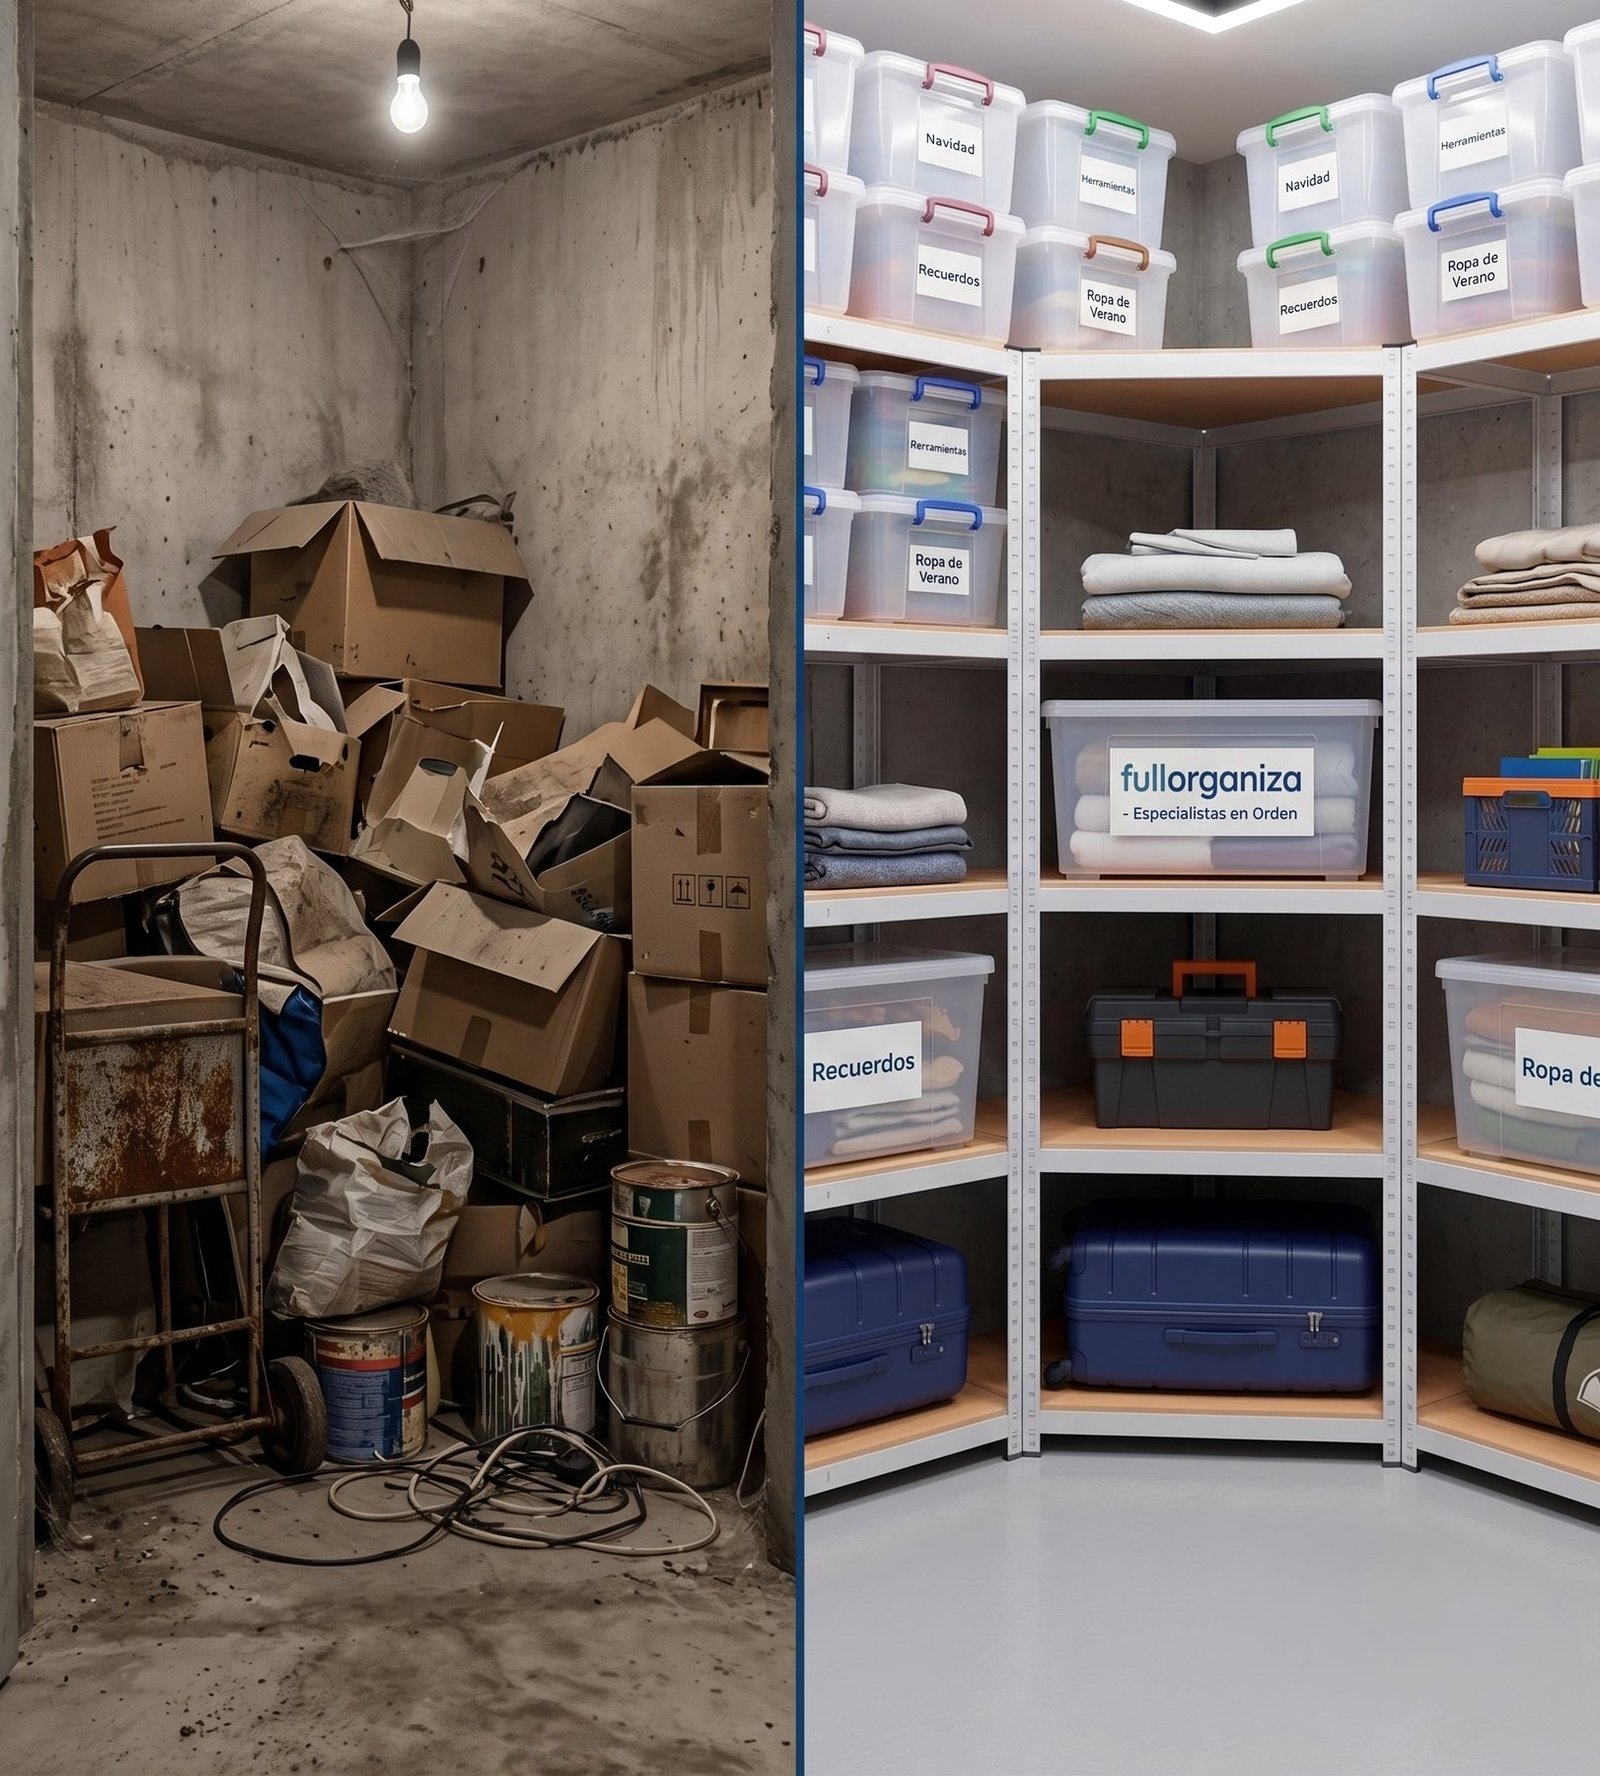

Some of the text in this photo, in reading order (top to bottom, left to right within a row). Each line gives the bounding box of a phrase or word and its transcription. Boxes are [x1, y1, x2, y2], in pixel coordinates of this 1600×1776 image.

[926, 132, 975, 155] Navidad
[1441, 127, 1506, 151] Herramientas
[1081, 174, 1136, 196] Herramientas
[1285, 170, 1330, 193] Navidad
[1447, 252, 1499, 273] Ropa de
[918, 263, 980, 288] Recuerdos
[1452, 270, 1496, 289] Verano
[1087, 289, 1130, 308] Ropa de
[1280, 295, 1338, 316] Recuerdos
[1089, 306, 1127, 324] Verano
[915, 553, 963, 570] Ropa de
[919, 570, 960, 586] Verano
[1120, 763, 1302, 800] fullorganiza
[1133, 805, 1227, 824] Especialistas
[1230, 809, 1248, 820] en
[1252, 806, 1298, 820] Orden
[812, 1052, 915, 1082] Recuerdos
[1522, 1056, 1600, 1088] Ropa de
